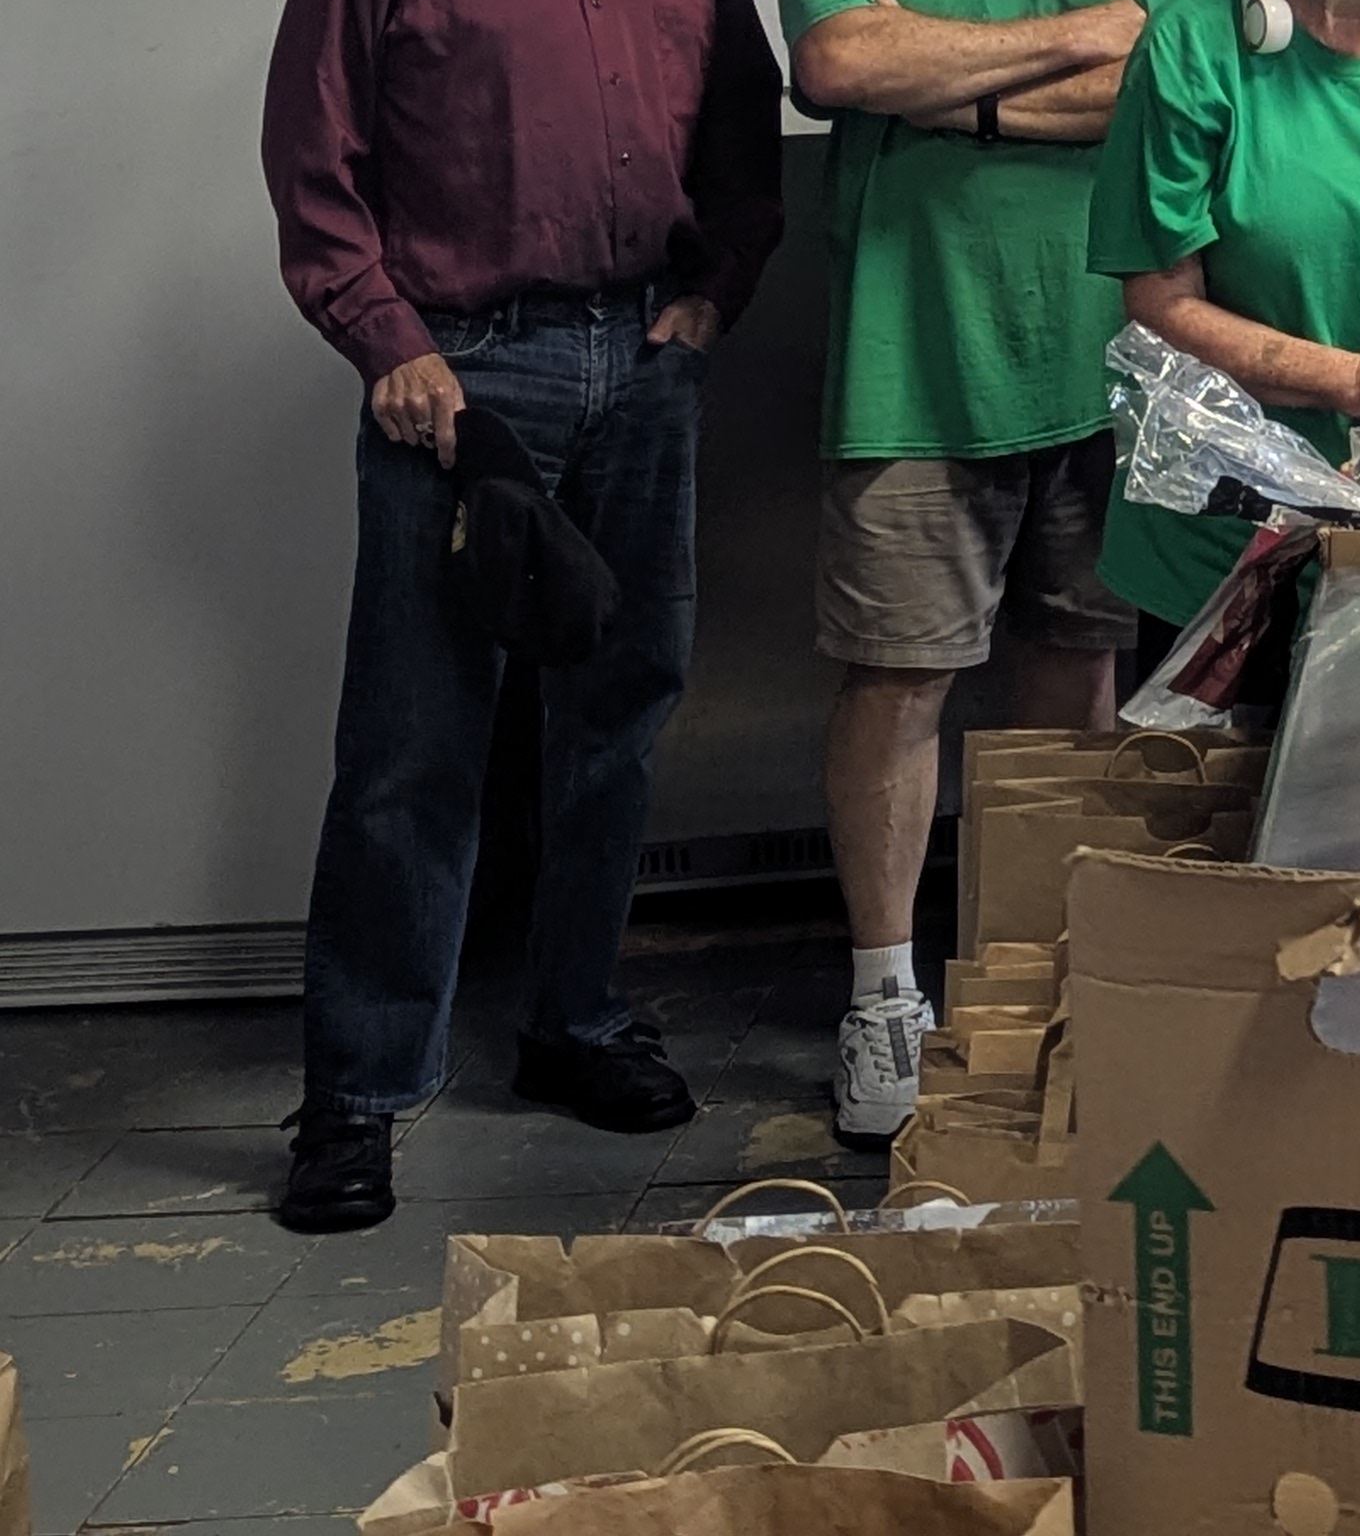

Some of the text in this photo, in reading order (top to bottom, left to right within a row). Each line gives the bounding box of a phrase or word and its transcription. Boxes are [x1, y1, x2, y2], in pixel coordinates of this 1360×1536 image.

[1150, 1209, 1180, 1424] THIS END UP
